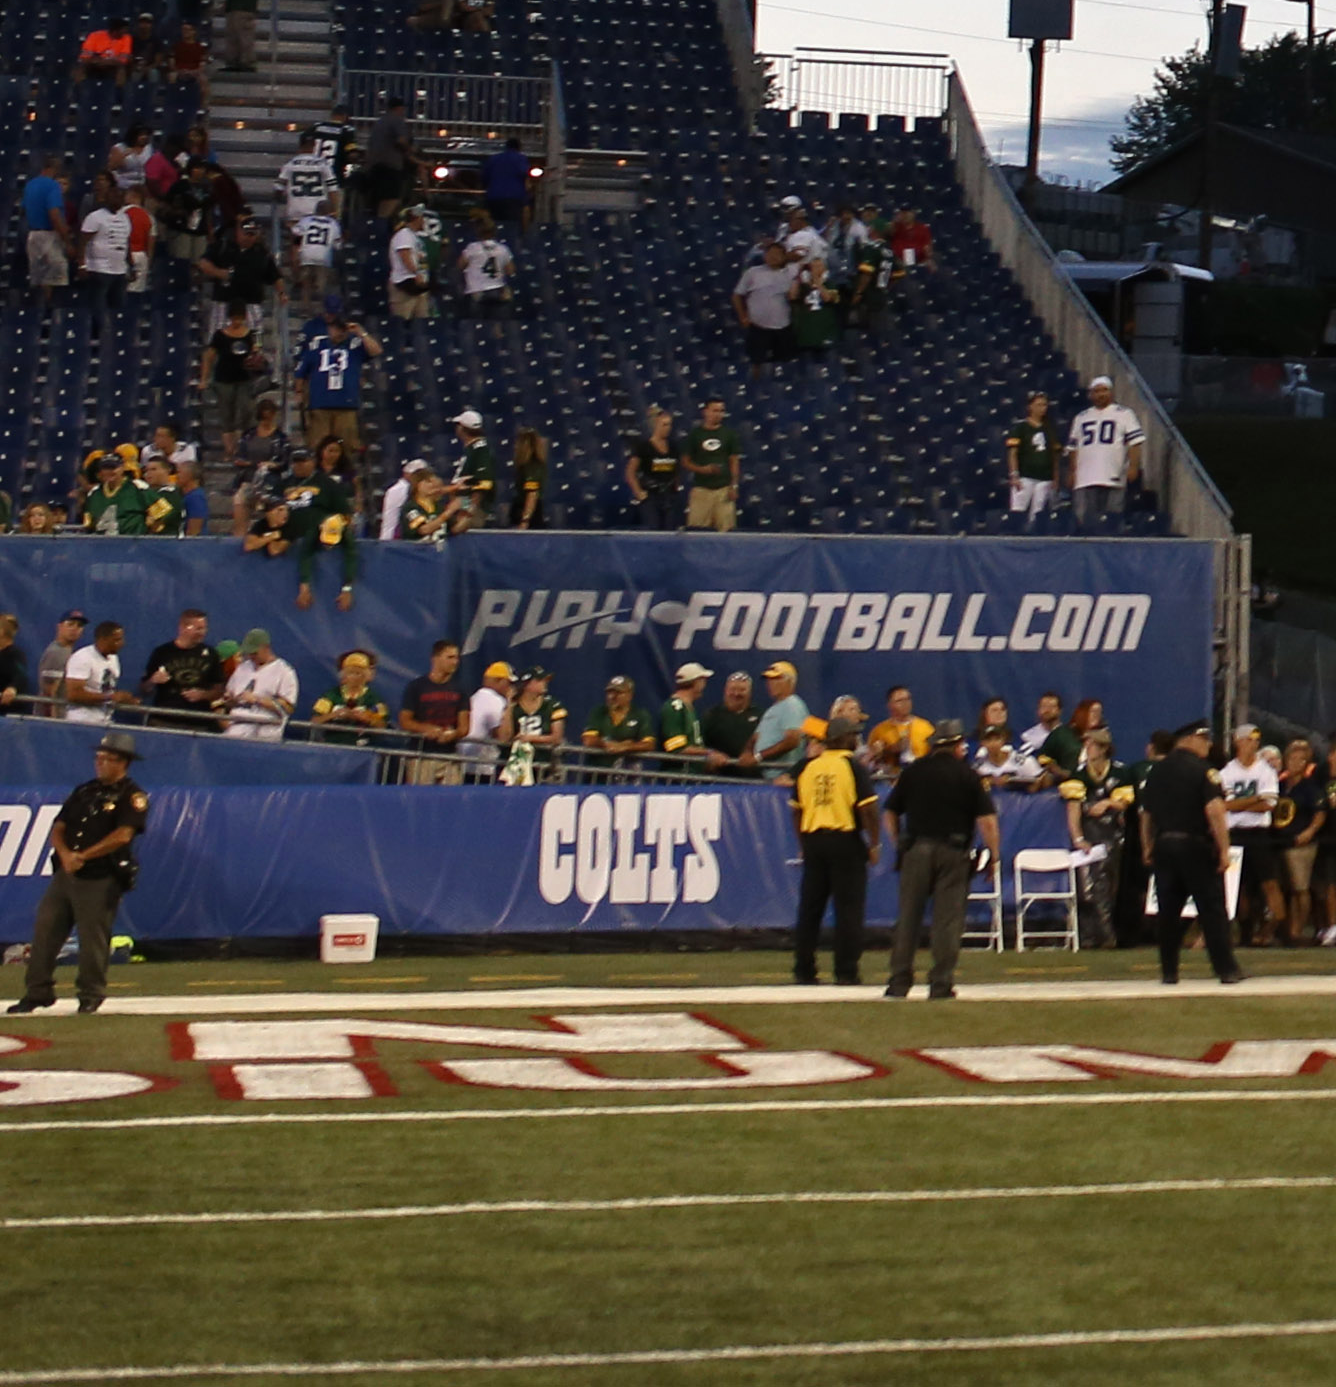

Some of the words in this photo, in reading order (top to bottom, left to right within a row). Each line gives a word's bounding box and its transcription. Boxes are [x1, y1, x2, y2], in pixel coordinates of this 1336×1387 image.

[291, 170, 325, 197] 52
[306, 225, 328, 246] 21
[480, 257, 499, 279] 4
[319, 348, 349, 372] 13
[1082, 419, 1115, 446] 50
[518, 715, 543, 736] 12
[538, 793, 722, 905] COLTS
